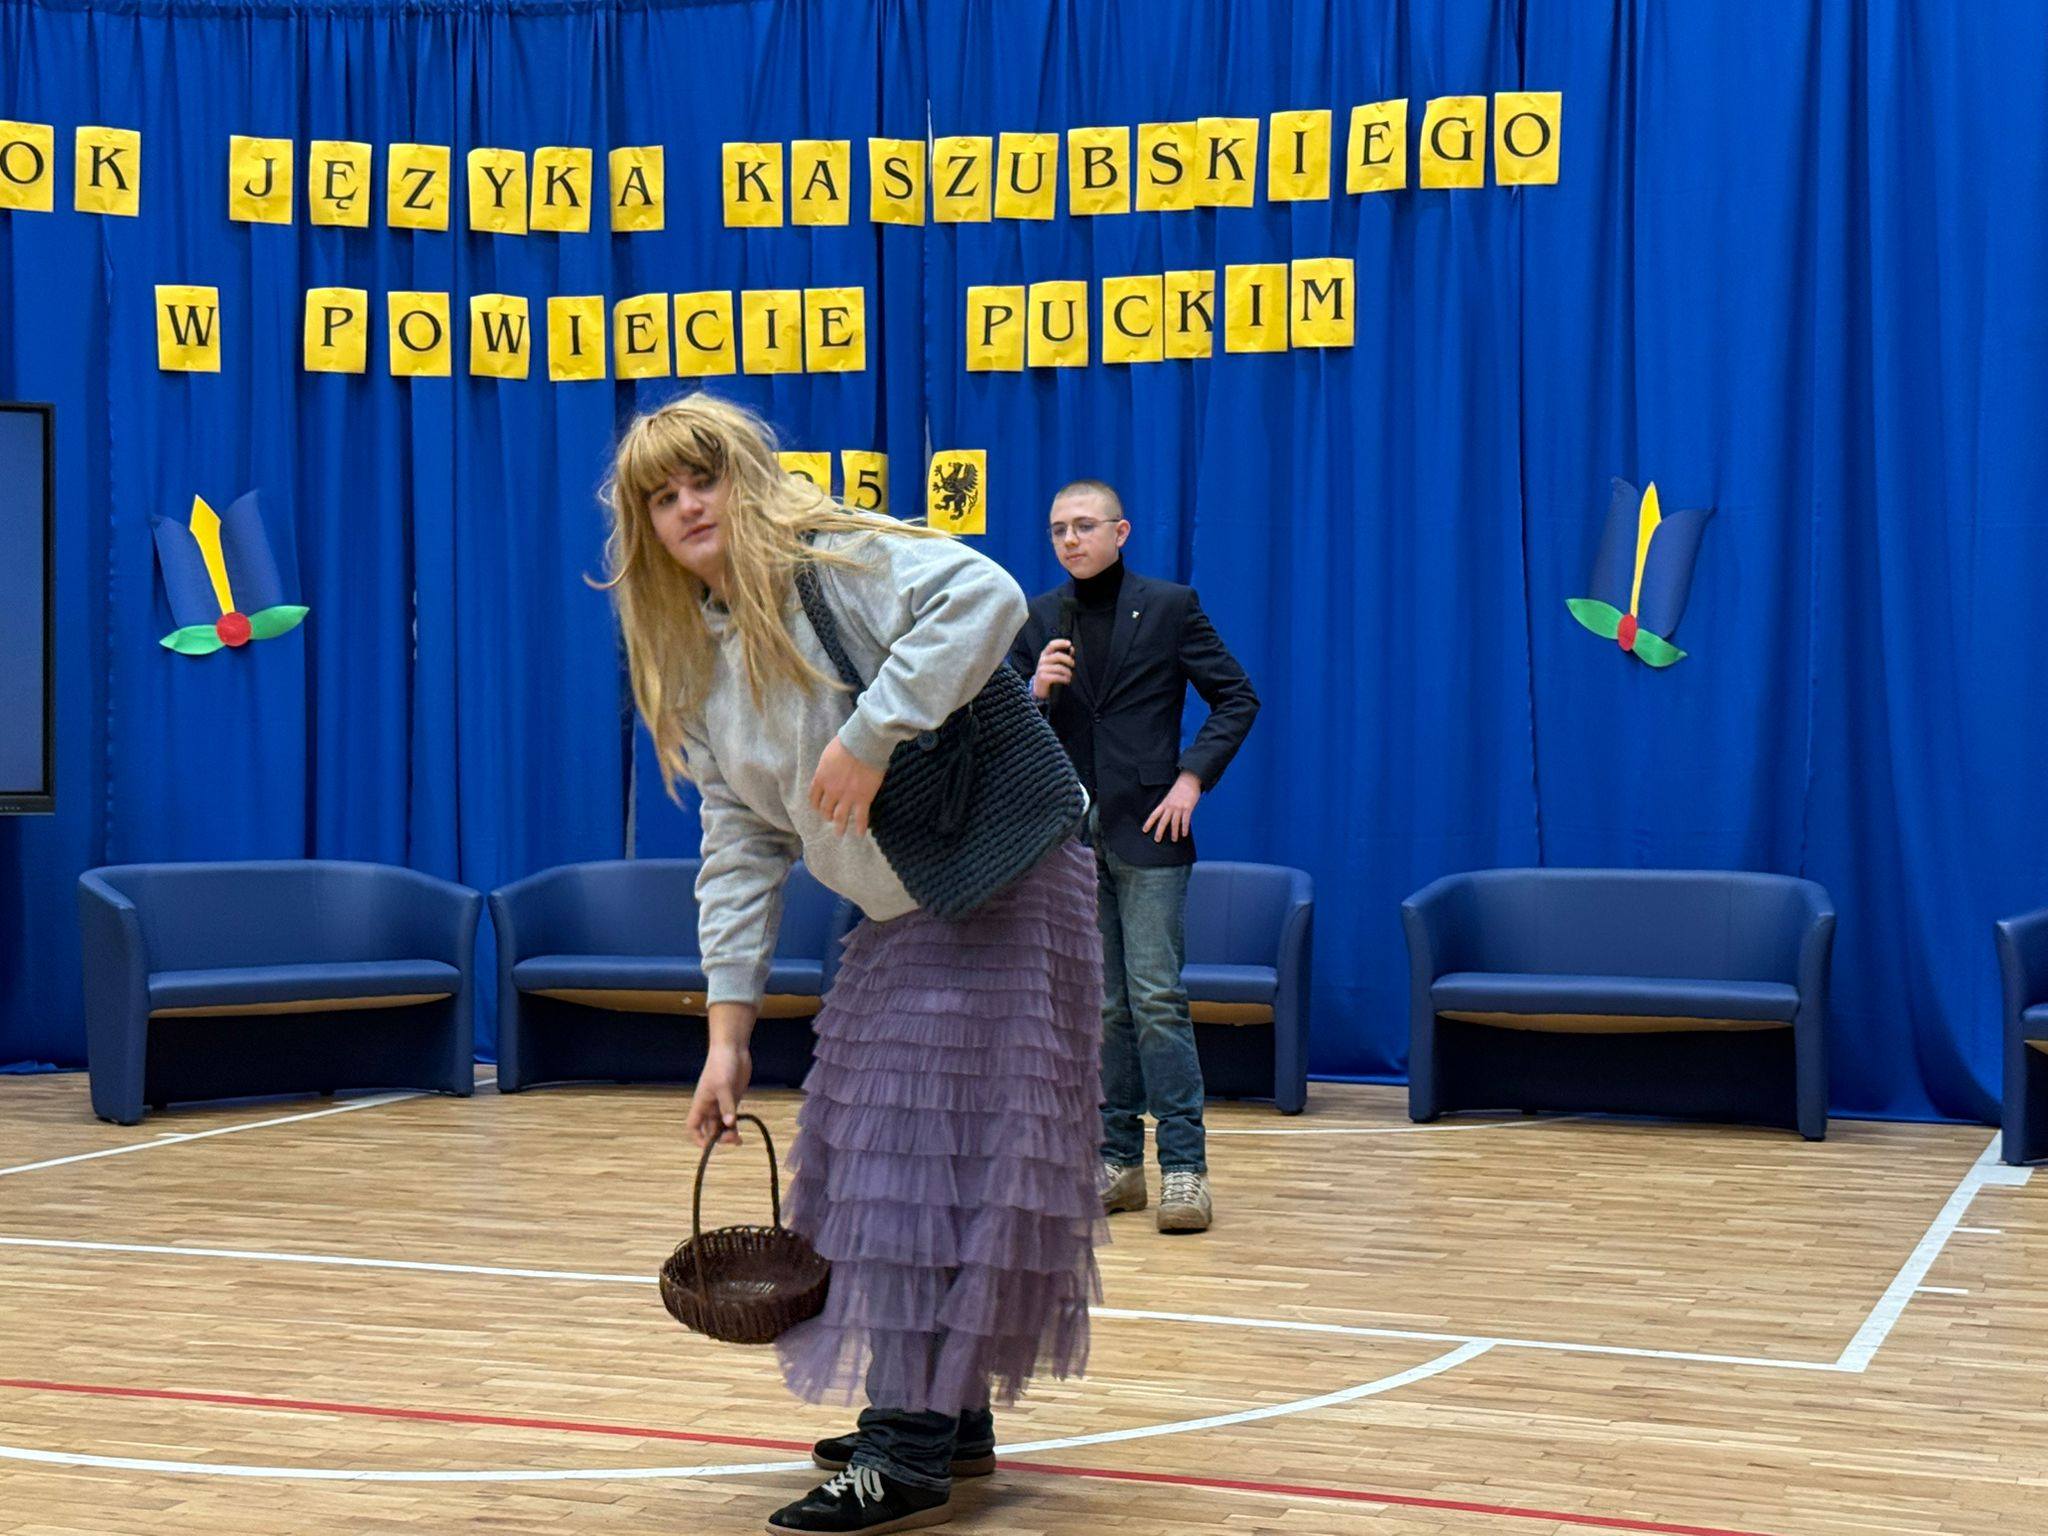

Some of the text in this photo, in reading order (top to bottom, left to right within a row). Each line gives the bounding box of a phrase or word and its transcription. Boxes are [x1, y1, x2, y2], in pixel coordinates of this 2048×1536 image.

[243, 157, 656, 210] JĘZYKA
[735, 112, 1552, 203] KASZUBSKIEGO
[166, 277, 1345, 356] W POWIECIE PUCKIM
